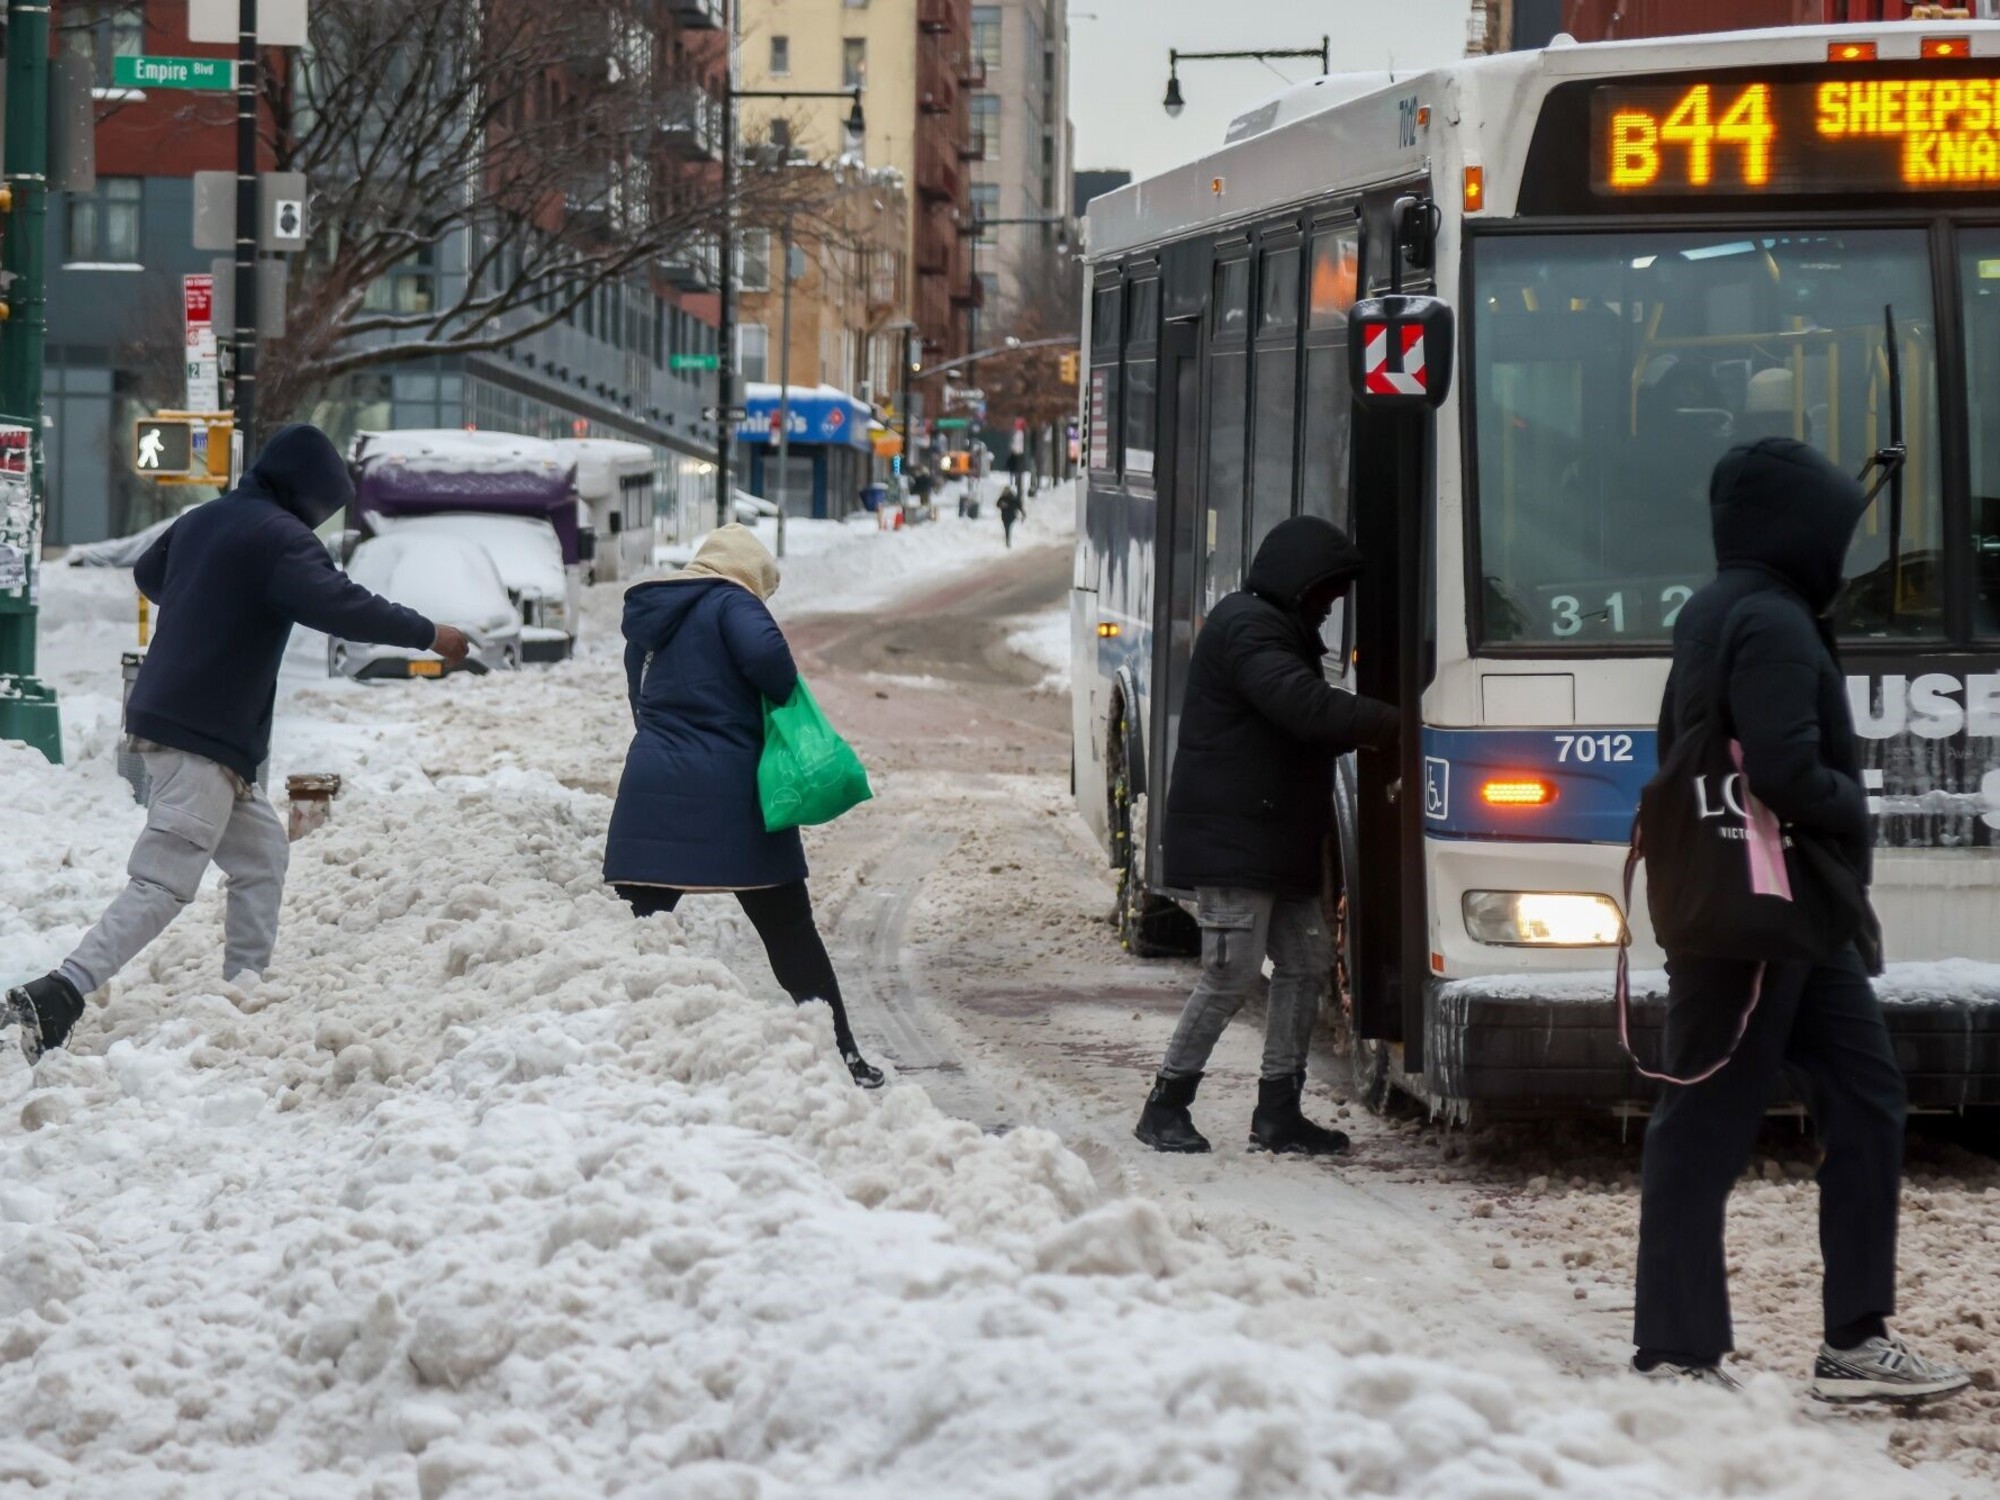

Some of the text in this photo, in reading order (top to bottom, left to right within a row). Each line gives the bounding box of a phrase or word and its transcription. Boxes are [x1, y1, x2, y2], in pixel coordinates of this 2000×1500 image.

[135, 59, 214, 84] Empire Blvd
[1818, 79, 2000, 135] SHEEPS
[1610, 82, 1773, 187] B44
[1554, 734, 1634, 762] 7012
